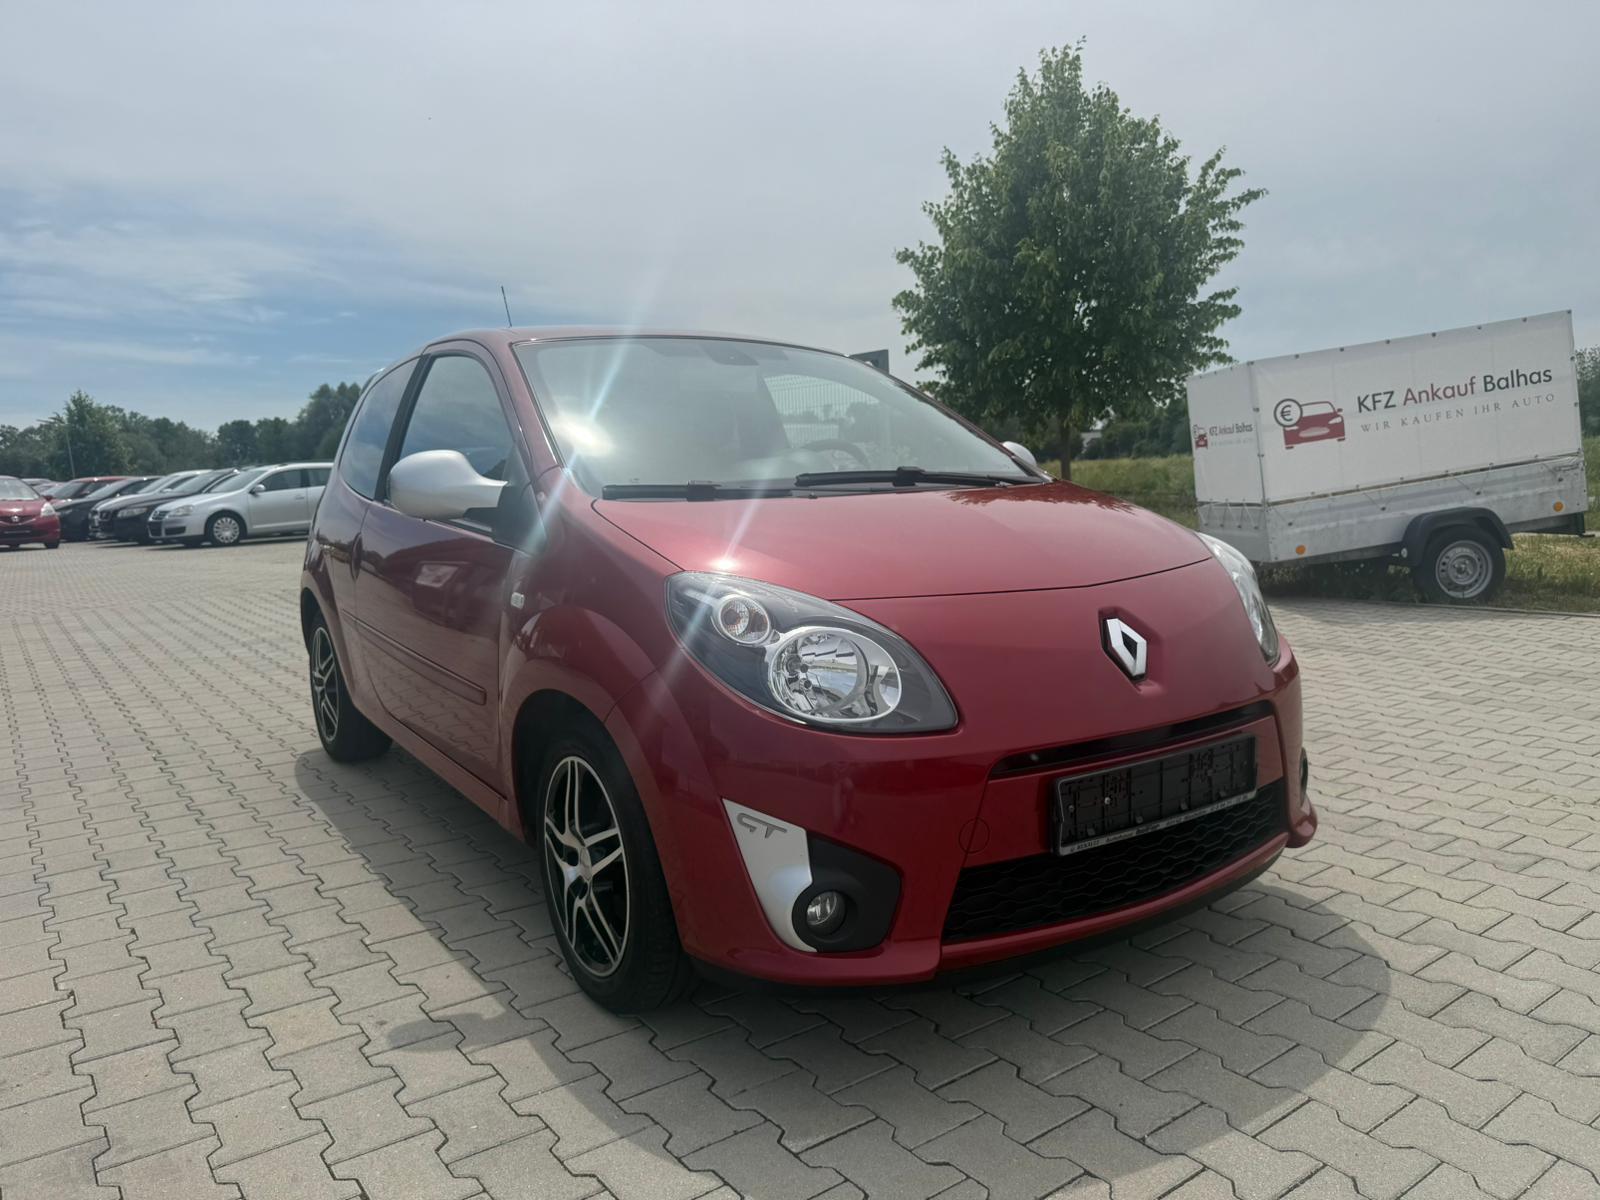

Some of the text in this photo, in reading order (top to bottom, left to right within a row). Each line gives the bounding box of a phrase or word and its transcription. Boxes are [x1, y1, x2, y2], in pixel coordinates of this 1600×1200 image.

[1357, 368, 1552, 413] KFZ Ankauf Balhas
[1361, 393, 1555, 433] WIR KAUFEN IHR AUTO
